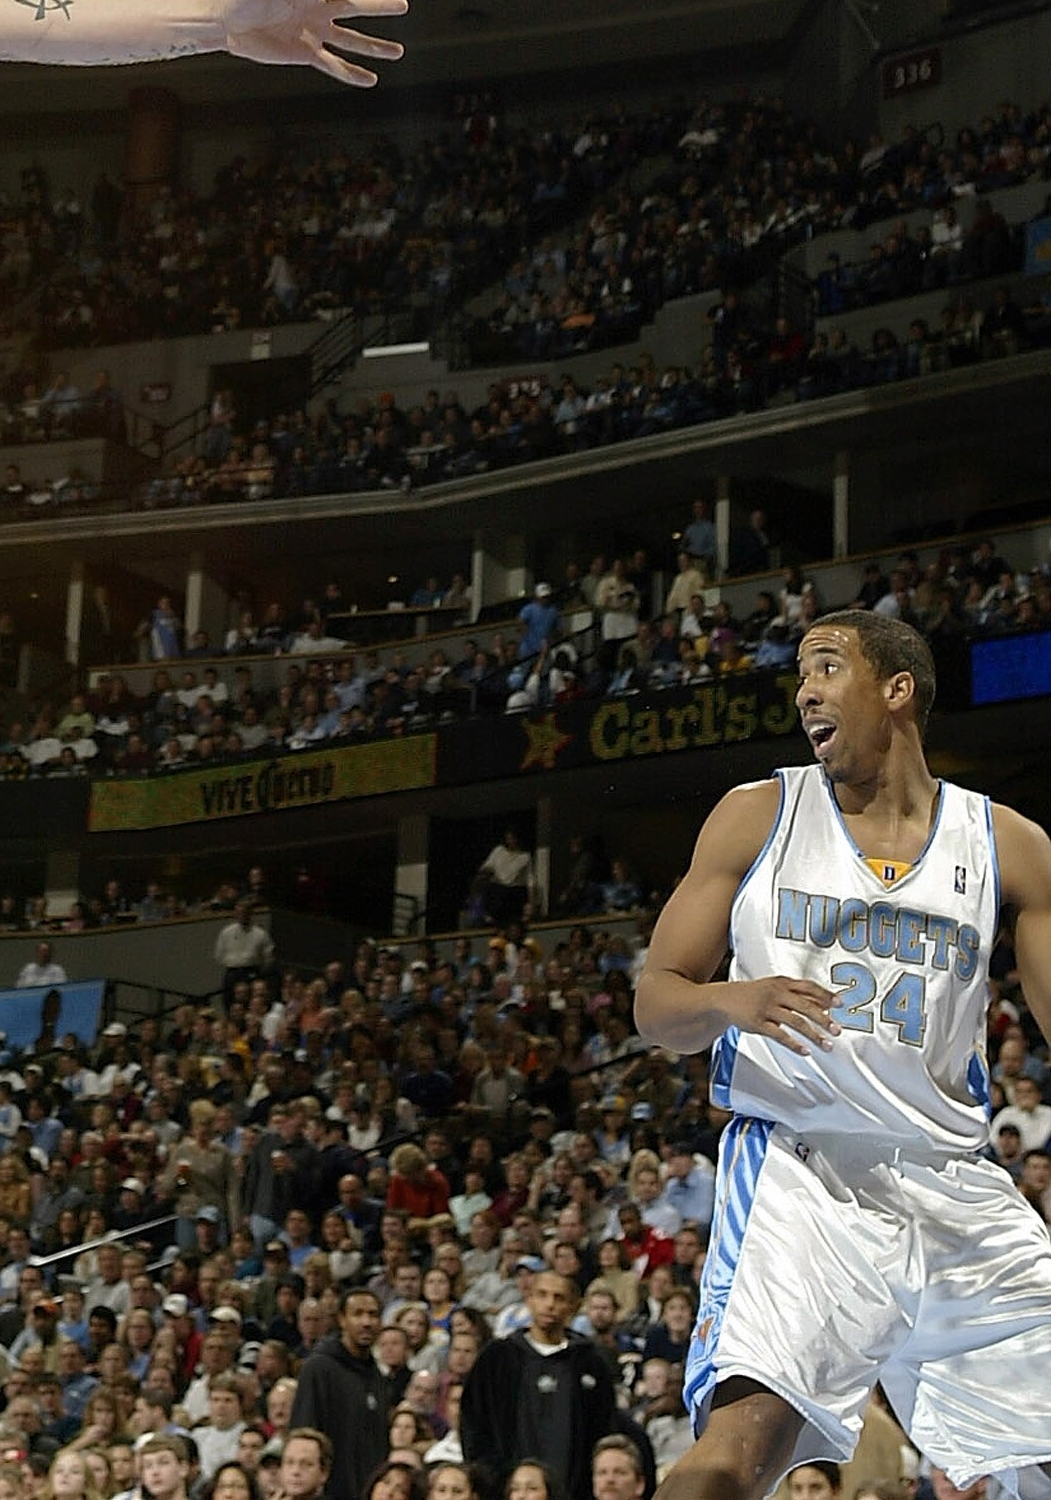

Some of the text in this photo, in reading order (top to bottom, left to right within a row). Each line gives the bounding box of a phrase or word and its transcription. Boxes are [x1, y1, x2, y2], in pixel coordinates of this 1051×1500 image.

[589, 687, 758, 761] Carl's
[775, 887, 981, 982] NUGGETS
[830, 961, 927, 1048] 24
